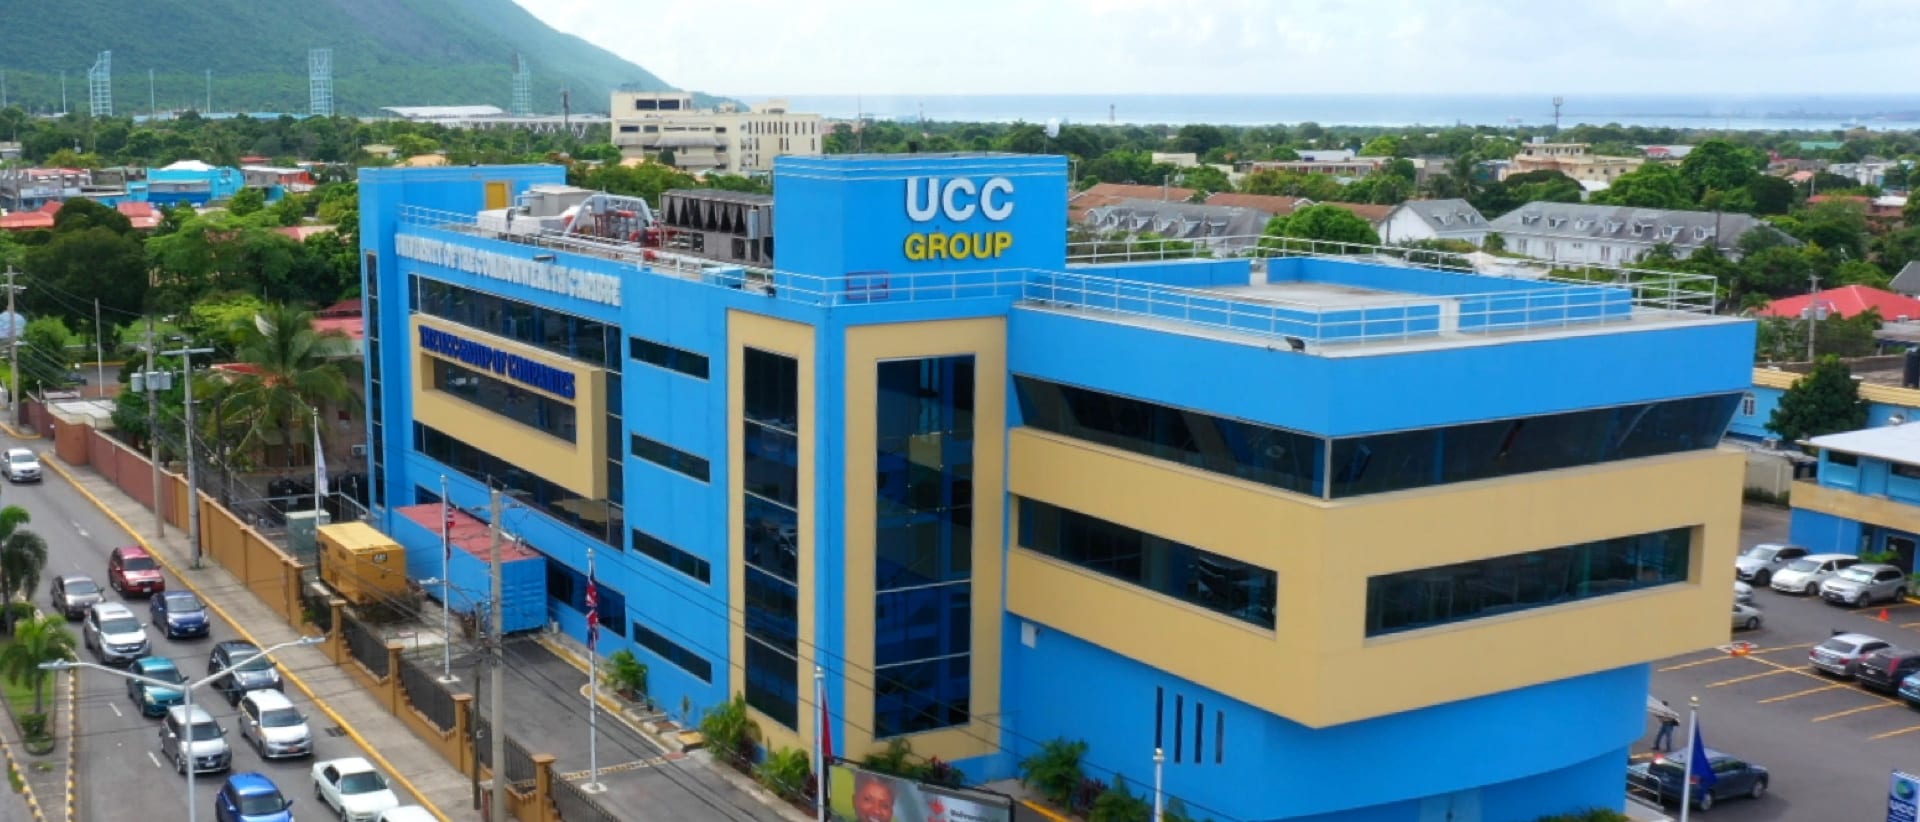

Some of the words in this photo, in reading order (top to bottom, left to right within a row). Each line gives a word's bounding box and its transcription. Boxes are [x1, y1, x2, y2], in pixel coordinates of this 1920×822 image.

[906, 176, 1013, 221] UCC
[905, 232, 1012, 260] GROUP
[459, 338, 491, 370] GROUP
[493, 347, 507, 375] OF
[508, 354, 575, 400] COMPANIES
